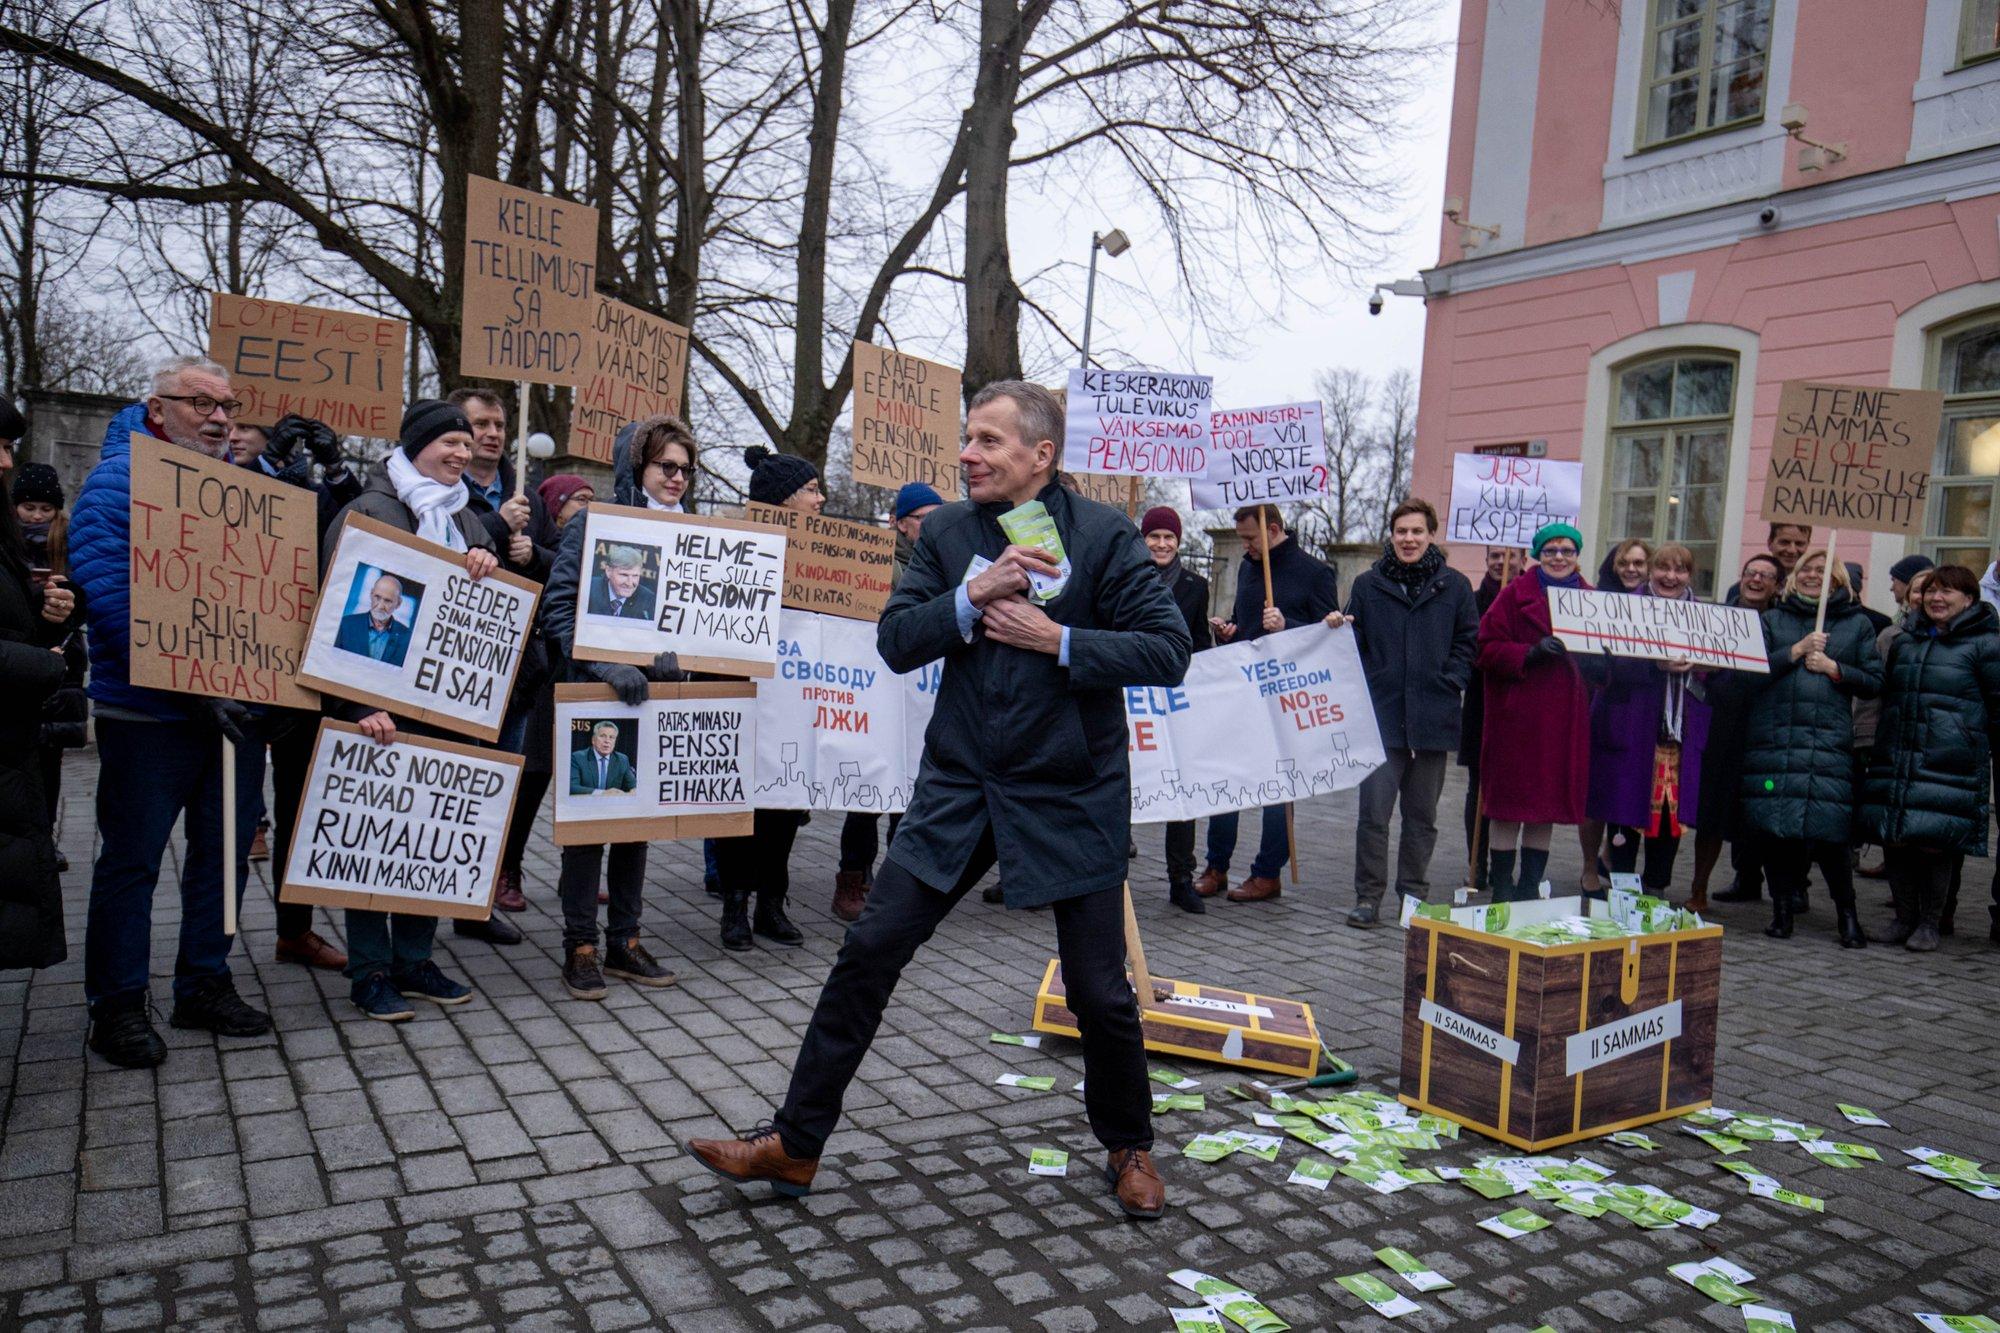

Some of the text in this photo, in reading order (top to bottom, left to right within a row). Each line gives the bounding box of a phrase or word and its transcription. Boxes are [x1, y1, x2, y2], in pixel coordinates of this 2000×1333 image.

[498, 196, 564, 247] KELLE
[471, 239, 594, 299] TELLIMUST
[217, 297, 394, 347] LÕPETAGE
[506, 287, 541, 328] SA
[483, 321, 581, 375] TÄIDAD?
[592, 298, 688, 366] ÕHKUMIST
[234, 335, 384, 391] EESTI
[597, 340, 670, 395] VÄÄRIB
[882, 351, 927, 384] KAED
[864, 371, 940, 413] EEMALE
[1083, 371, 1213, 400] KESKERAKOND:
[876, 398, 923, 430] MINU
[1092, 394, 1199, 419] TULEVIKUS
[1210, 407, 1314, 429] EAMINISTRI-
[1805, 387, 1900, 421] TEINE
[863, 418, 944, 457] PENSIONI-
[1099, 416, 1203, 439] VÄIKSEMAD
[1210, 421, 1306, 450] TOOL VÕI
[1782, 412, 1911, 447] SAMMAS
[1087, 437, 1205, 472] PENSIONID
[1232, 444, 1312, 475] NOORTE
[1793, 437, 1887, 469] EI OLE
[159, 457, 285, 539] TOOME
[1217, 465, 1328, 504] TULEVIK?
[1479, 484, 1548, 512] KUULA
[751, 507, 798, 529] TEINE
[1773, 486, 1913, 527] RAHAKOTT!
[133, 500, 311, 586] TERVE
[811, 541, 856, 560] PENSIONI
[133, 546, 314, 625] MÕISTUSE
[666, 559, 711, 584] MEIE
[721, 565, 777, 588] SULLE
[795, 562, 852, 585] KINDLASTI
[665, 580, 776, 612] PENSIONIT
[813, 588, 853, 608] RATAS
[191, 598, 257, 643] RIIGI
[437, 604, 521, 645] SINA MEILT
[657, 605, 771, 646] EI MAKSA
[1557, 590, 1751, 640] KUS ON PEAMINISTRI
[134, 618, 302, 676] JUHTIMISS
[426, 622, 513, 676] PENSIONI
[777, 639, 802, 657] ЗА
[159, 653, 278, 701] TAGASI
[414, 657, 494, 711] EI SAA
[781, 660, 876, 691] СВОБОДУ
[1240, 658, 1297, 682] YES TO
[1258, 669, 1332, 698] FREEDOM
[803, 687, 854, 705] ПРОТИВ
[1279, 691, 1328, 713] NO TO
[813, 706, 869, 734] ЛЖИ
[1295, 704, 1345, 731] LIES
[658, 733, 739, 758] PENSSI
[330, 739, 504, 799] MIKS NOORED
[658, 759, 739, 776] PLEKKIMA
[322, 773, 482, 826] PEAVAD TEIE
[659, 777, 745, 802] EI HAKKA
[306, 849, 370, 884] KINNI
[1434, 1011, 1498, 1050] II SAMMAS
[1591, 1016, 1664, 1059] II SAMMAS
[1775, 1188, 1796, 1199] 100
